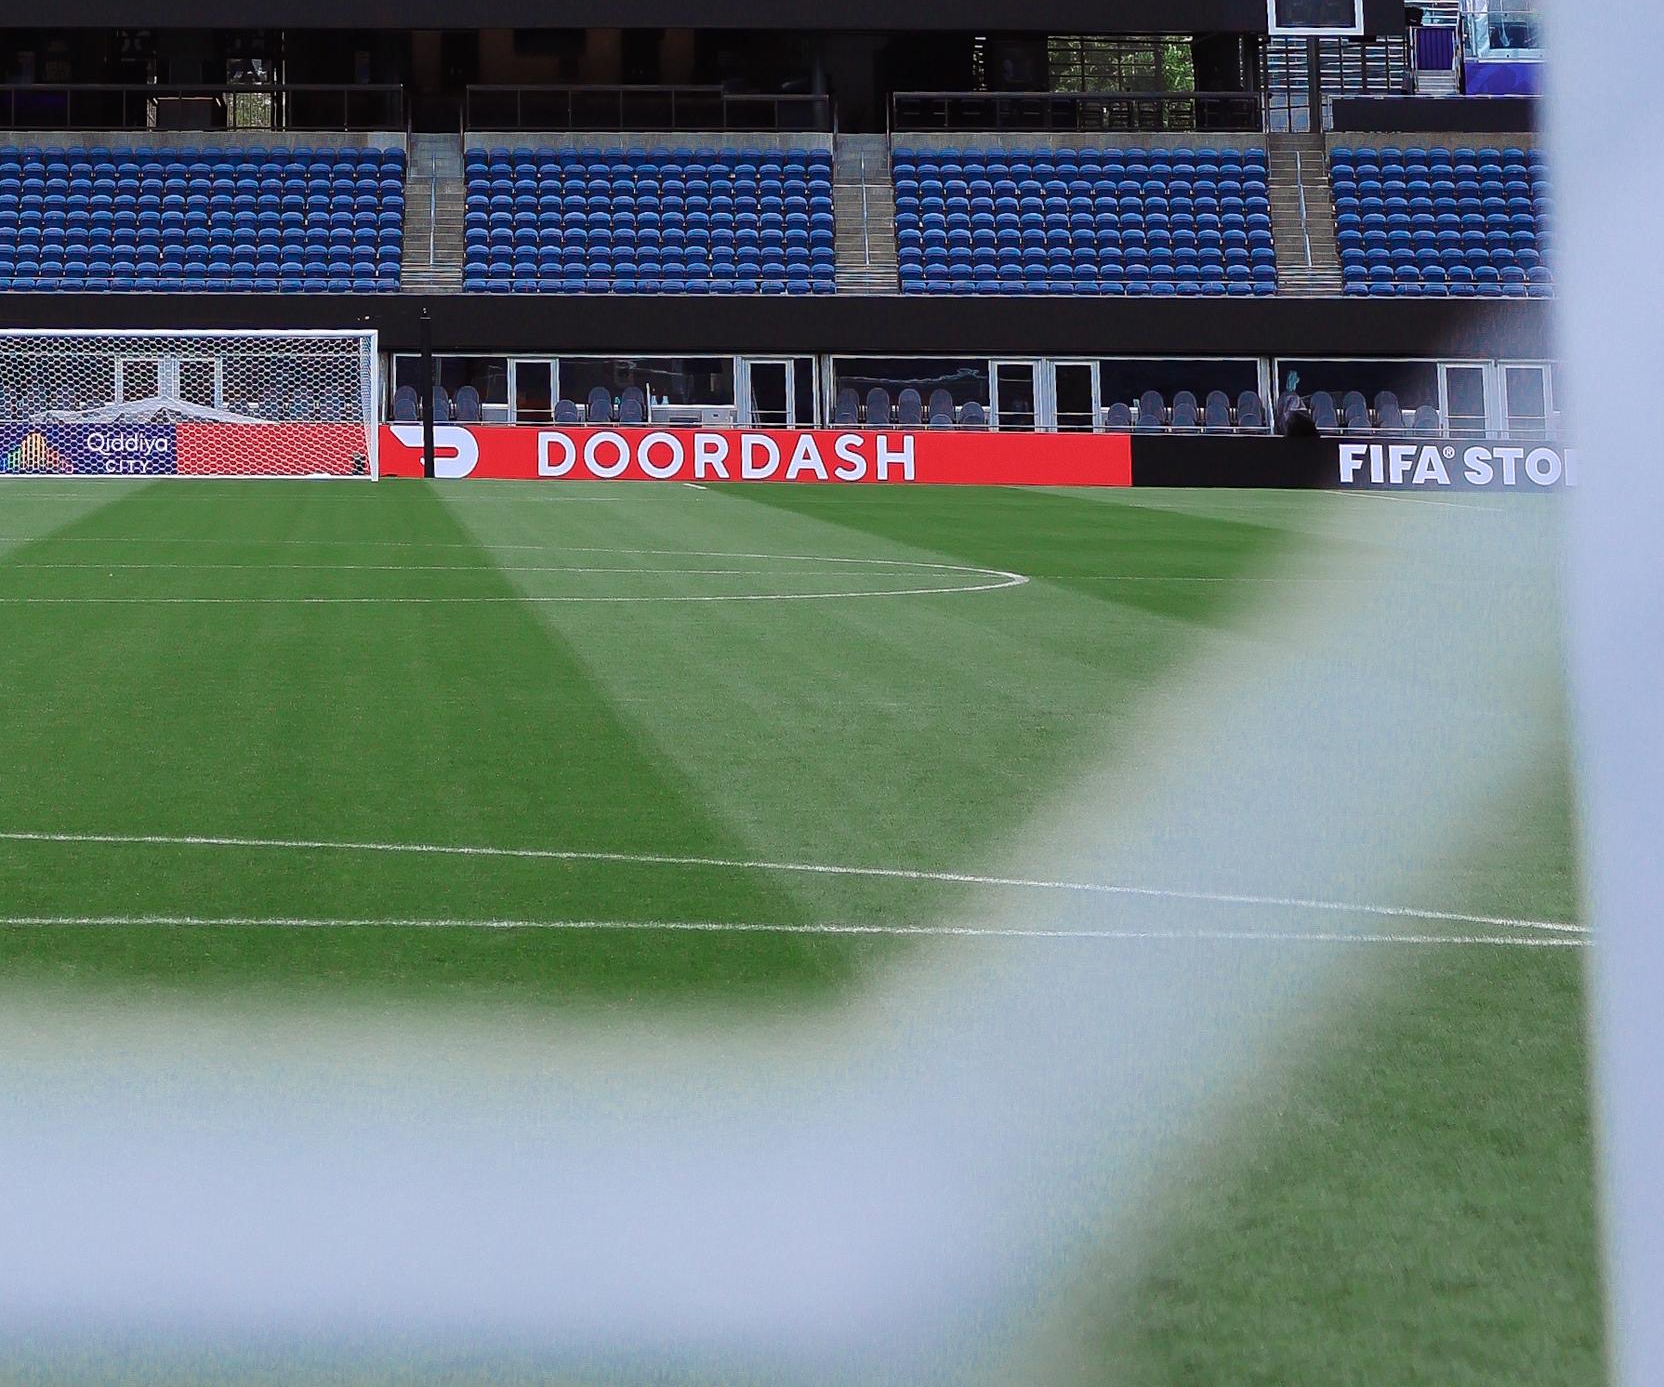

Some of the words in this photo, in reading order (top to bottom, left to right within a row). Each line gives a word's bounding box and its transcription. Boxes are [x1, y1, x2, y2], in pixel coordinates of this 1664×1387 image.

[87, 432, 168, 456] Qiddiya
[537, 431, 916, 481] DOORDASH
[105, 459, 149, 473] CITY
